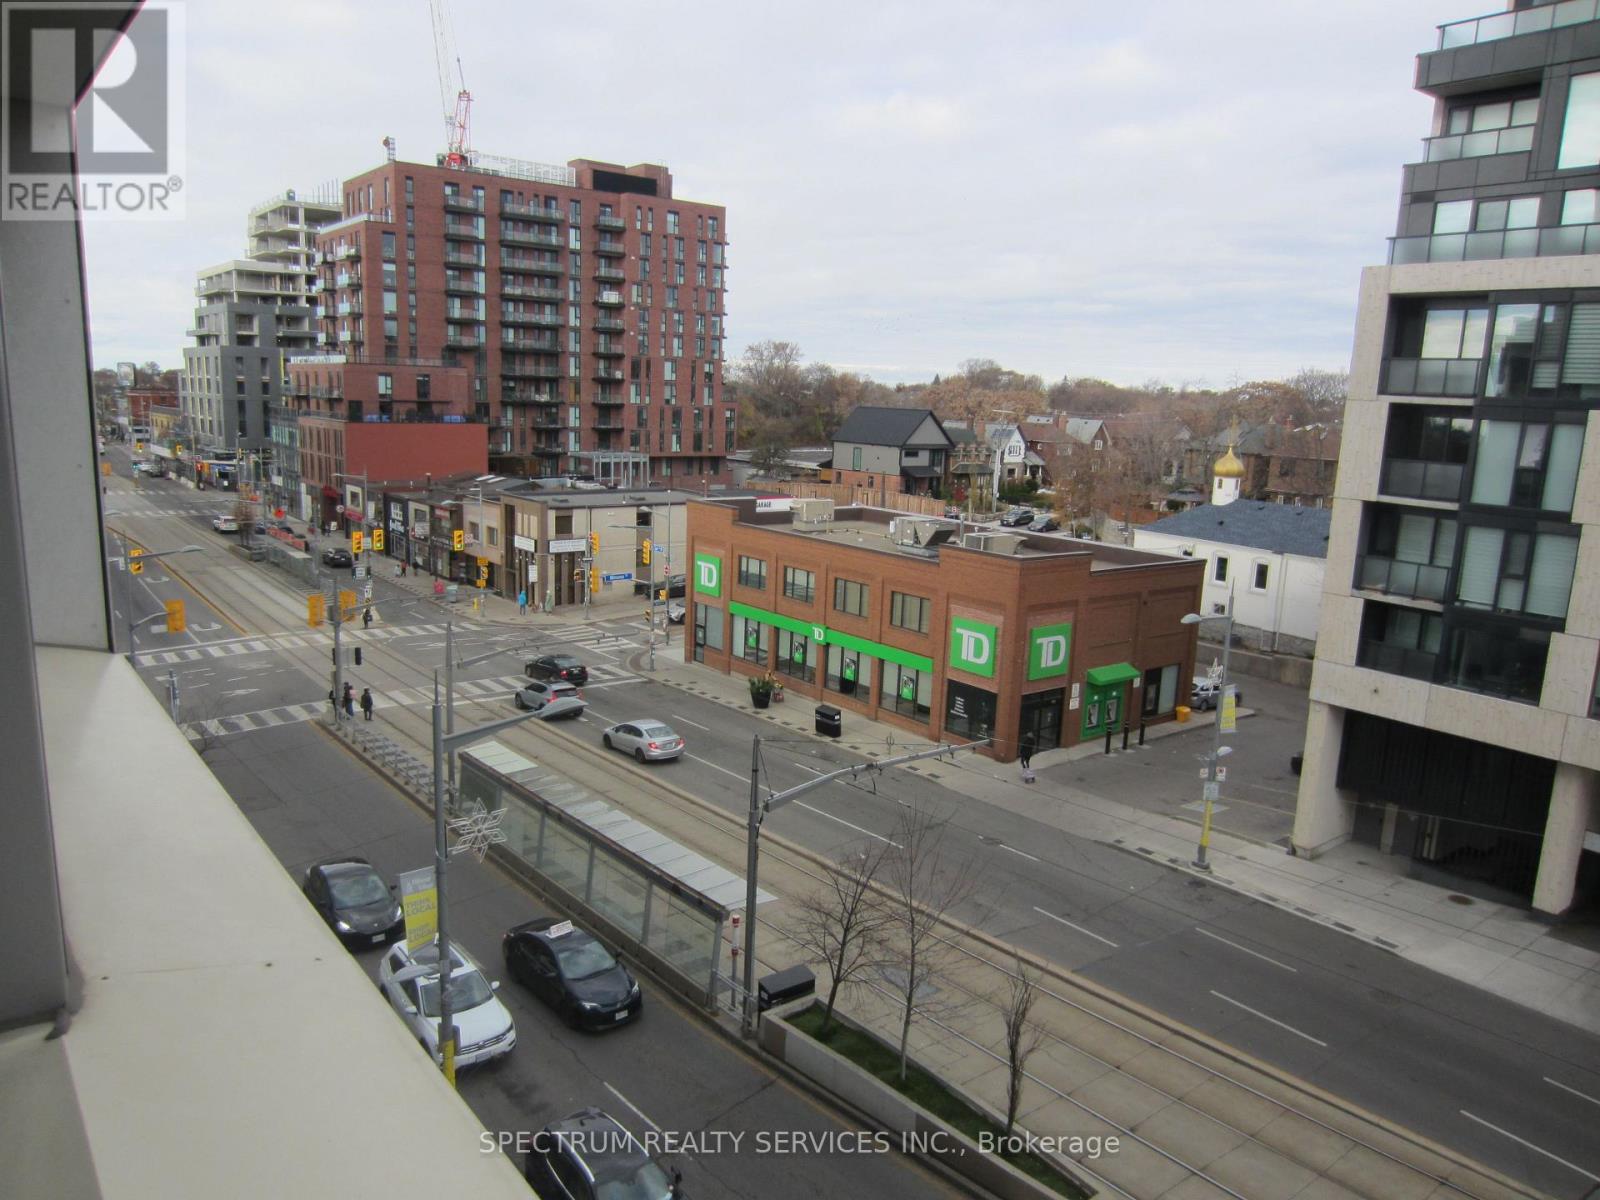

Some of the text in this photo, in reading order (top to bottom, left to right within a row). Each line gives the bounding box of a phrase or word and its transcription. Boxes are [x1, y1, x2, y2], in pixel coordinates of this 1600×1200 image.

[697, 561, 717, 588] TD
[812, 627, 824, 641] TD
[956, 628, 990, 664] TD
[1036, 635, 1066, 668] TD
